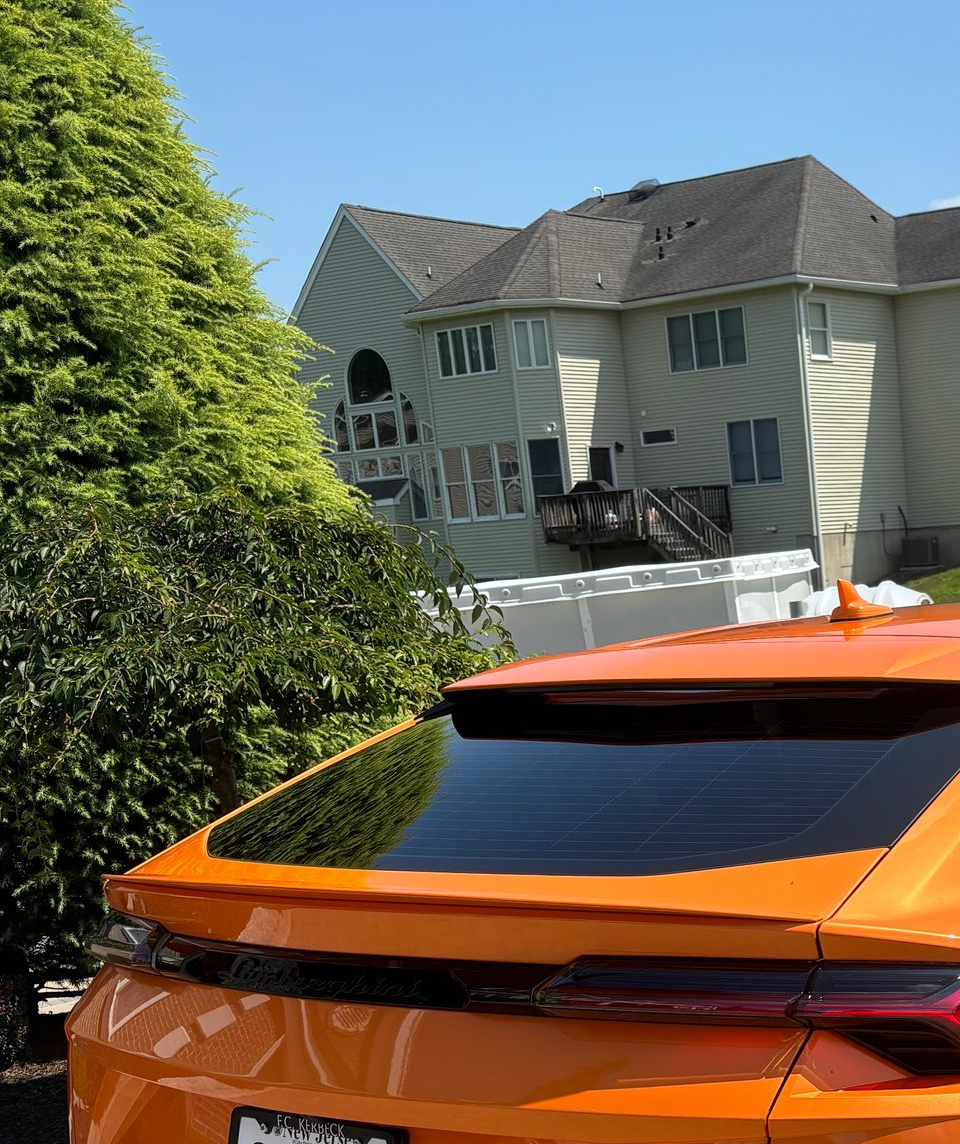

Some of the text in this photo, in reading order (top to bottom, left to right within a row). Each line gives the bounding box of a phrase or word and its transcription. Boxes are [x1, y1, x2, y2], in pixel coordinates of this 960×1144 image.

[217, 955, 424, 998] Lamborghini
[283, 1127, 310, 1141] New
[298, 1118, 345, 1138] KERBECK
